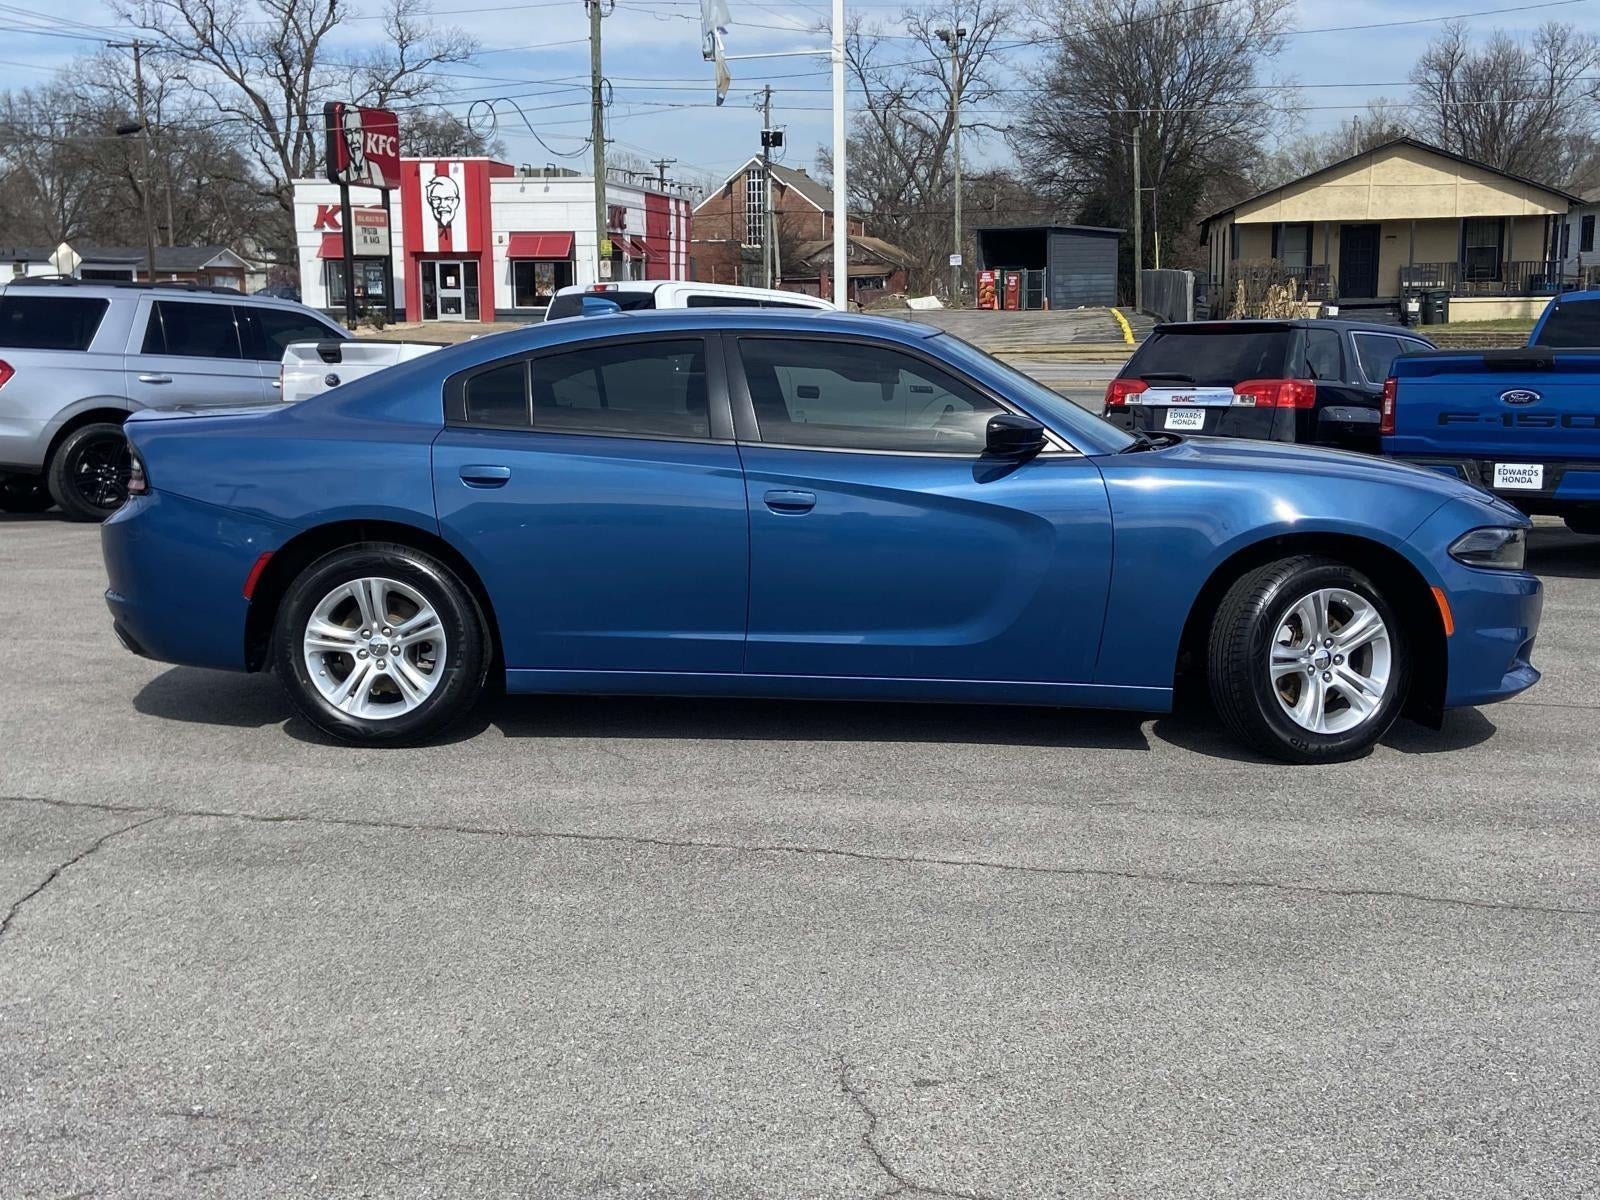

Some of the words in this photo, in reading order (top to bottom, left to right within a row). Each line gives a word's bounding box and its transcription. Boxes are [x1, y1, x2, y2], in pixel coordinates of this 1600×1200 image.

[366, 132, 397, 158] KFC
[1497, 468, 1539, 476] EDWARDS
[1501, 476, 1533, 484] HONDA
